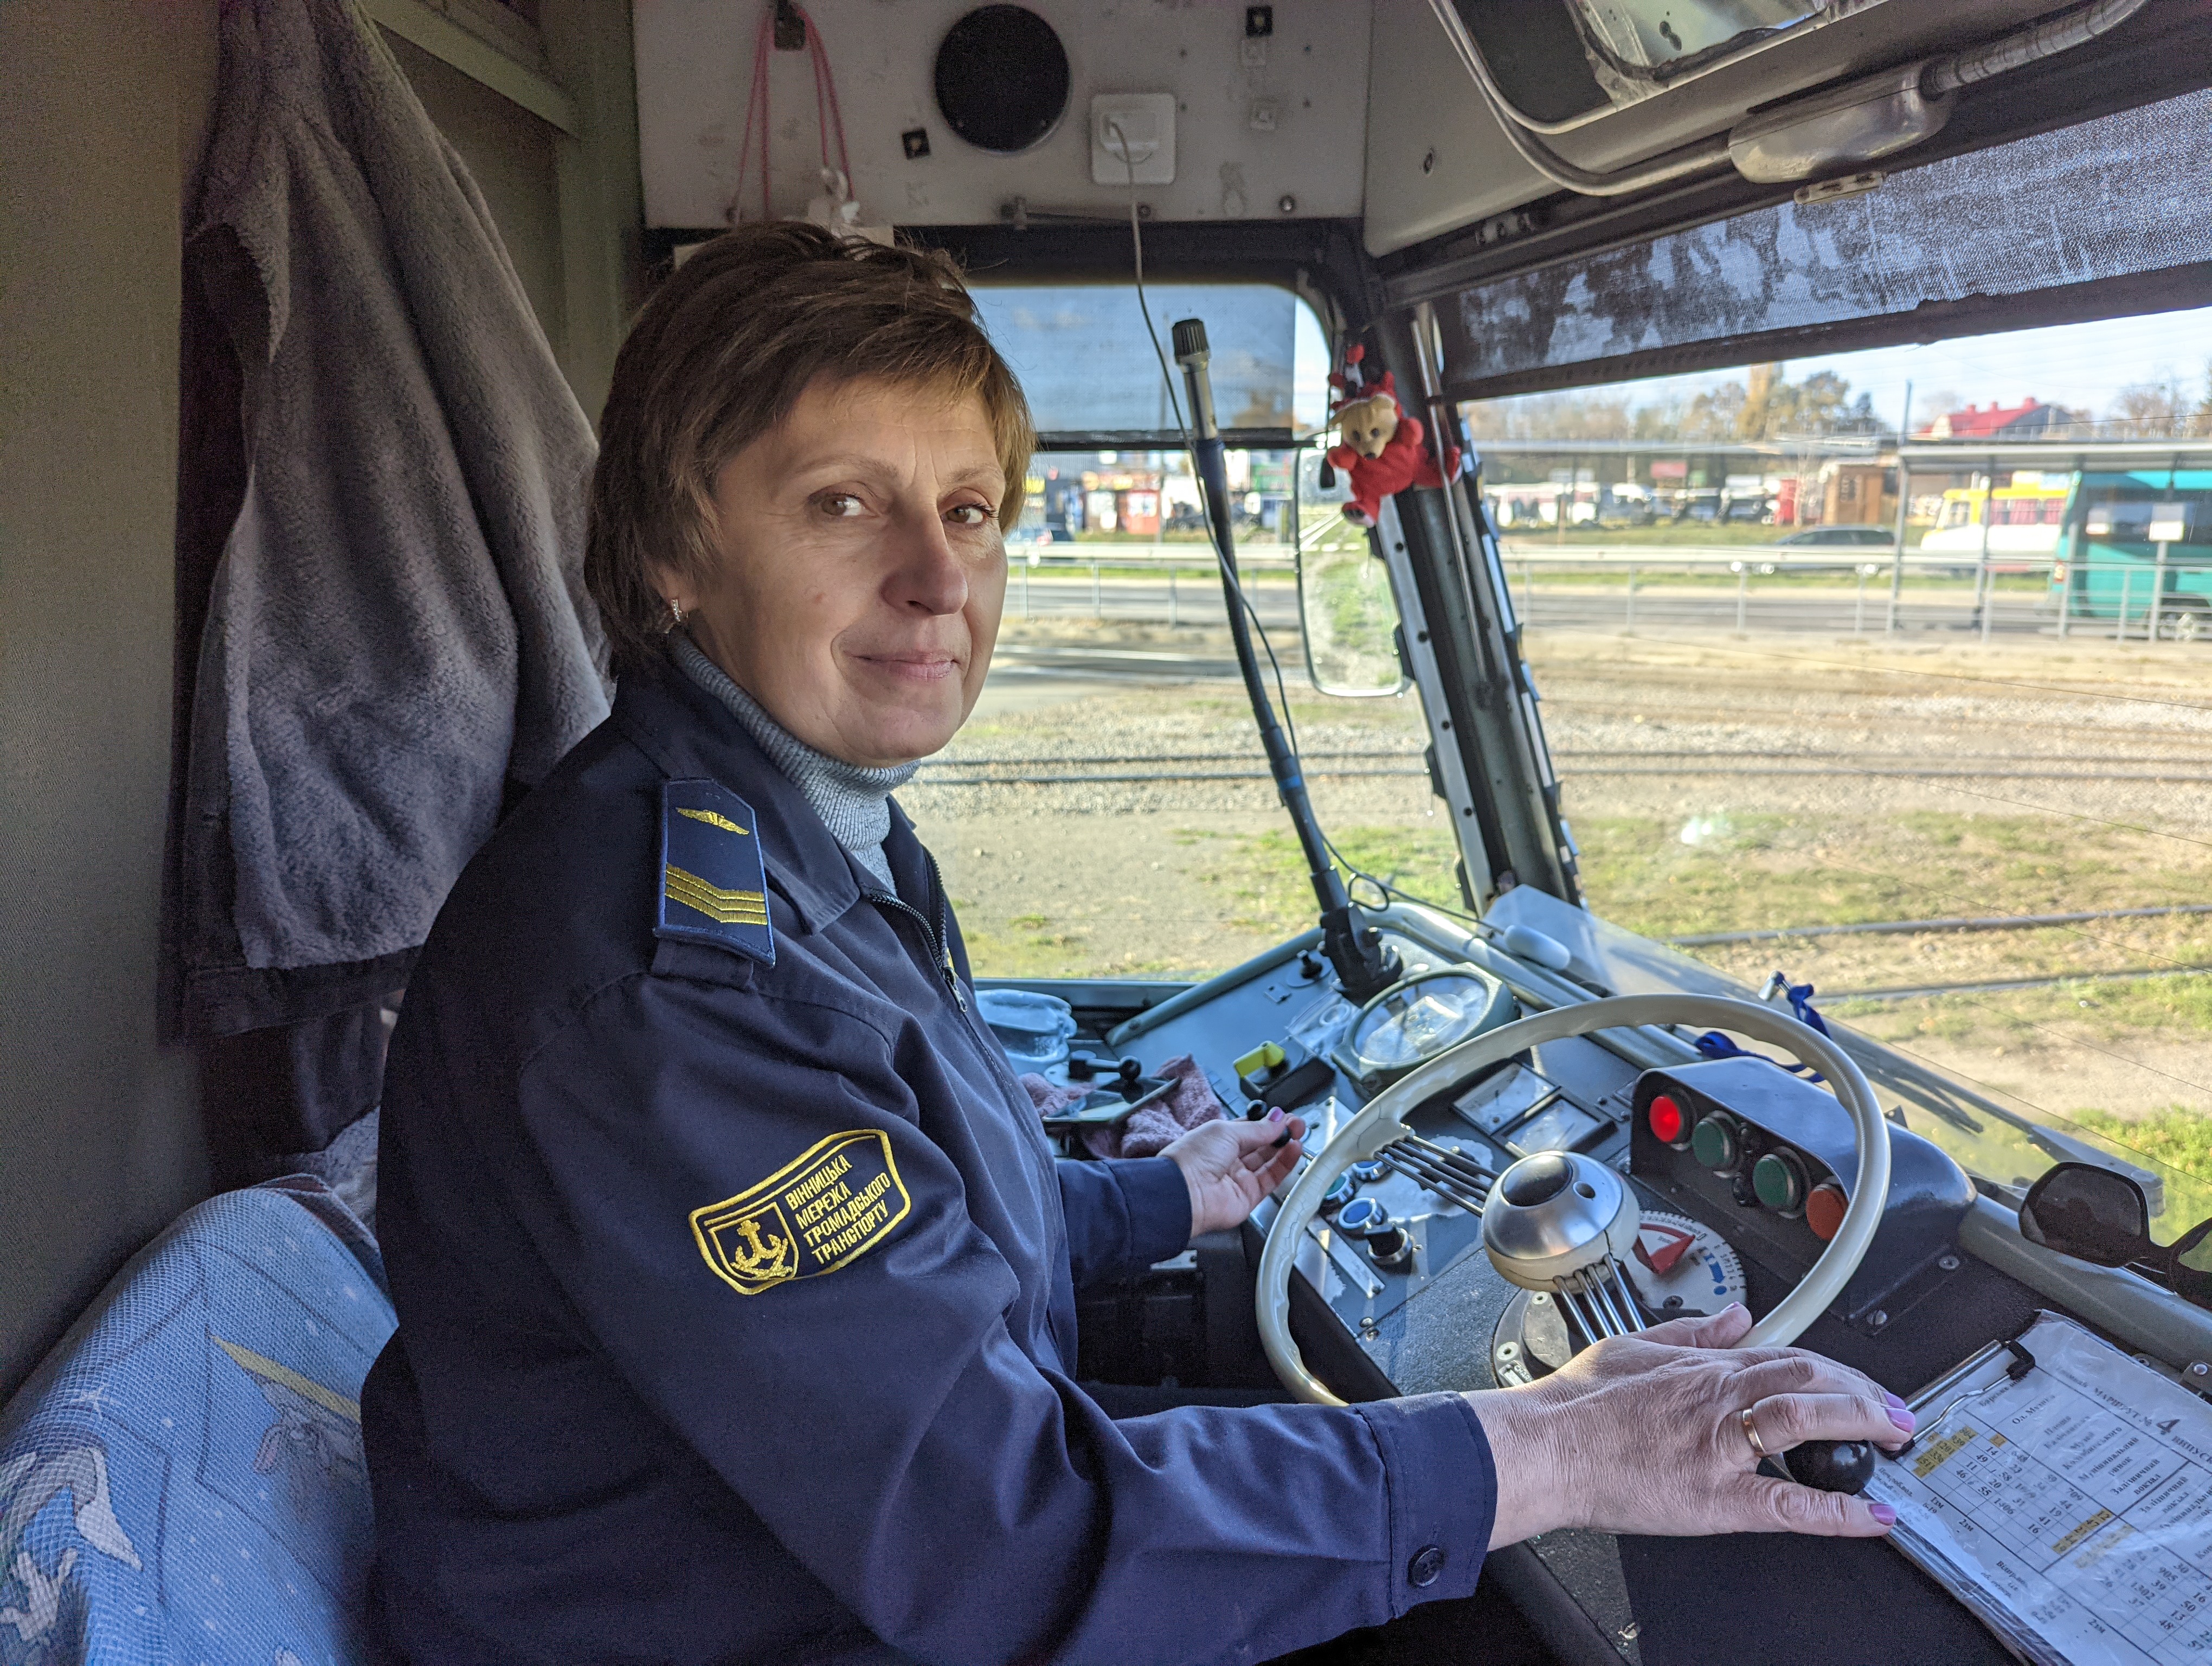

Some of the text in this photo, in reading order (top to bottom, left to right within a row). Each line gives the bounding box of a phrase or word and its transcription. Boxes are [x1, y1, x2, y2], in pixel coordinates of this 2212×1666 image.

[785, 1154, 853, 1210] ВІННИЦЬКА
[795, 1181, 852, 1229] МЕРЕЖА
[803, 1172, 891, 1247] ГРОМАДСЬКОГО
[812, 1200, 889, 1264] ТРАНСПОРТУ
[2156, 1415, 2181, 1434] 4
[1985, 1445, 1999, 1457] 14
[1975, 1453, 1989, 1464] 49
[1965, 1460, 1978, 1471] 11
[1955, 1468, 1968, 1479] 46
[1988, 1477, 2003, 1490] 20
[2133, 1472, 2162, 1496] вокзал
[1977, 1485, 1992, 1497] 55
[2048, 1505, 2063, 1518] 19
[2037, 1515, 2052, 1526] 41
[2027, 1522, 2041, 1535] 16
[2157, 1566, 2179, 1583] 905
[2130, 1580, 2156, 1601] 1302
[2150, 1579, 2167, 1592] 39
[2127, 1597, 2145, 1609] 37
[2192, 1591, 2207, 1604] 16
[2179, 1599, 2197, 1613] 50
[2170, 1609, 2187, 1622] 13
[2158, 1618, 2175, 1631] 48
[2187, 1639, 2205, 1652] 57
